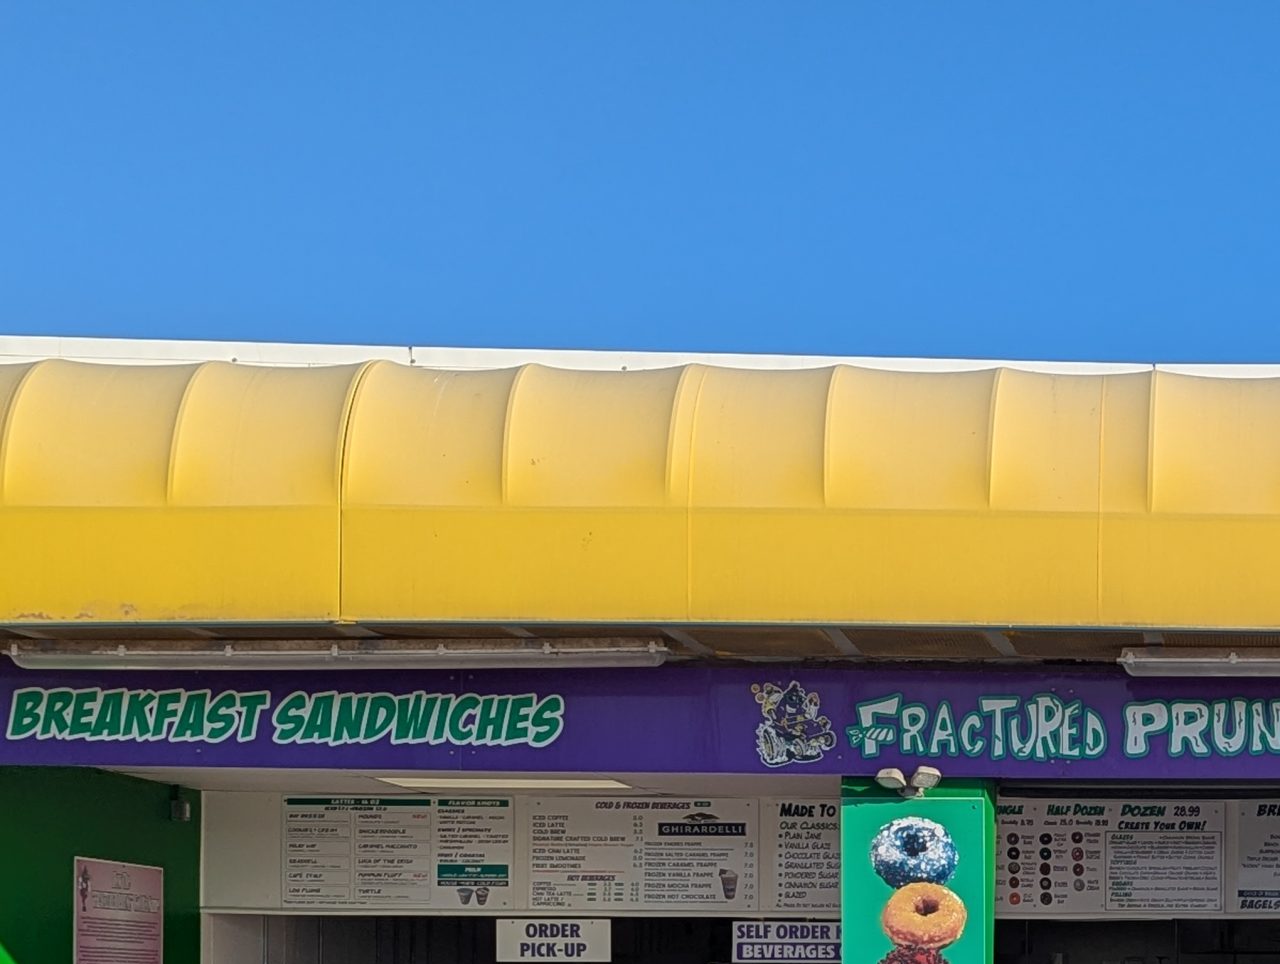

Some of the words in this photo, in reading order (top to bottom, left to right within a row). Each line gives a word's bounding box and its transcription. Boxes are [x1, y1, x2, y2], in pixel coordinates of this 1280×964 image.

[7, 687, 271, 741] BREAKFAST
[273, 690, 564, 748] SANDWICHES
[853, 693, 1106, 759] FRACTURED
[779, 803, 815, 817] MADE
[819, 804, 836, 817] TO
[1047, 805, 1071, 816] HALF
[1073, 804, 1105, 816] DOZEN
[1120, 804, 1166, 817] DOZEN
[1173, 805, 1201, 817] 28.99
[780, 821, 798, 830] OUR
[1118, 821, 1150, 831] CREATE
[1154, 821, 1177, 831] YOUR
[1179, 820, 1207, 832] OWN!
[784, 842, 810, 850] VANILLA
[1240, 899, 1280, 910] BAGELS
[525, 922, 581, 938] ORDER
[737, 924, 771, 939] SELF
[775, 924, 831, 939] ORDER
[519, 942, 587, 958] PICK-UP
[742, 944, 835, 959] BEVERAGES
